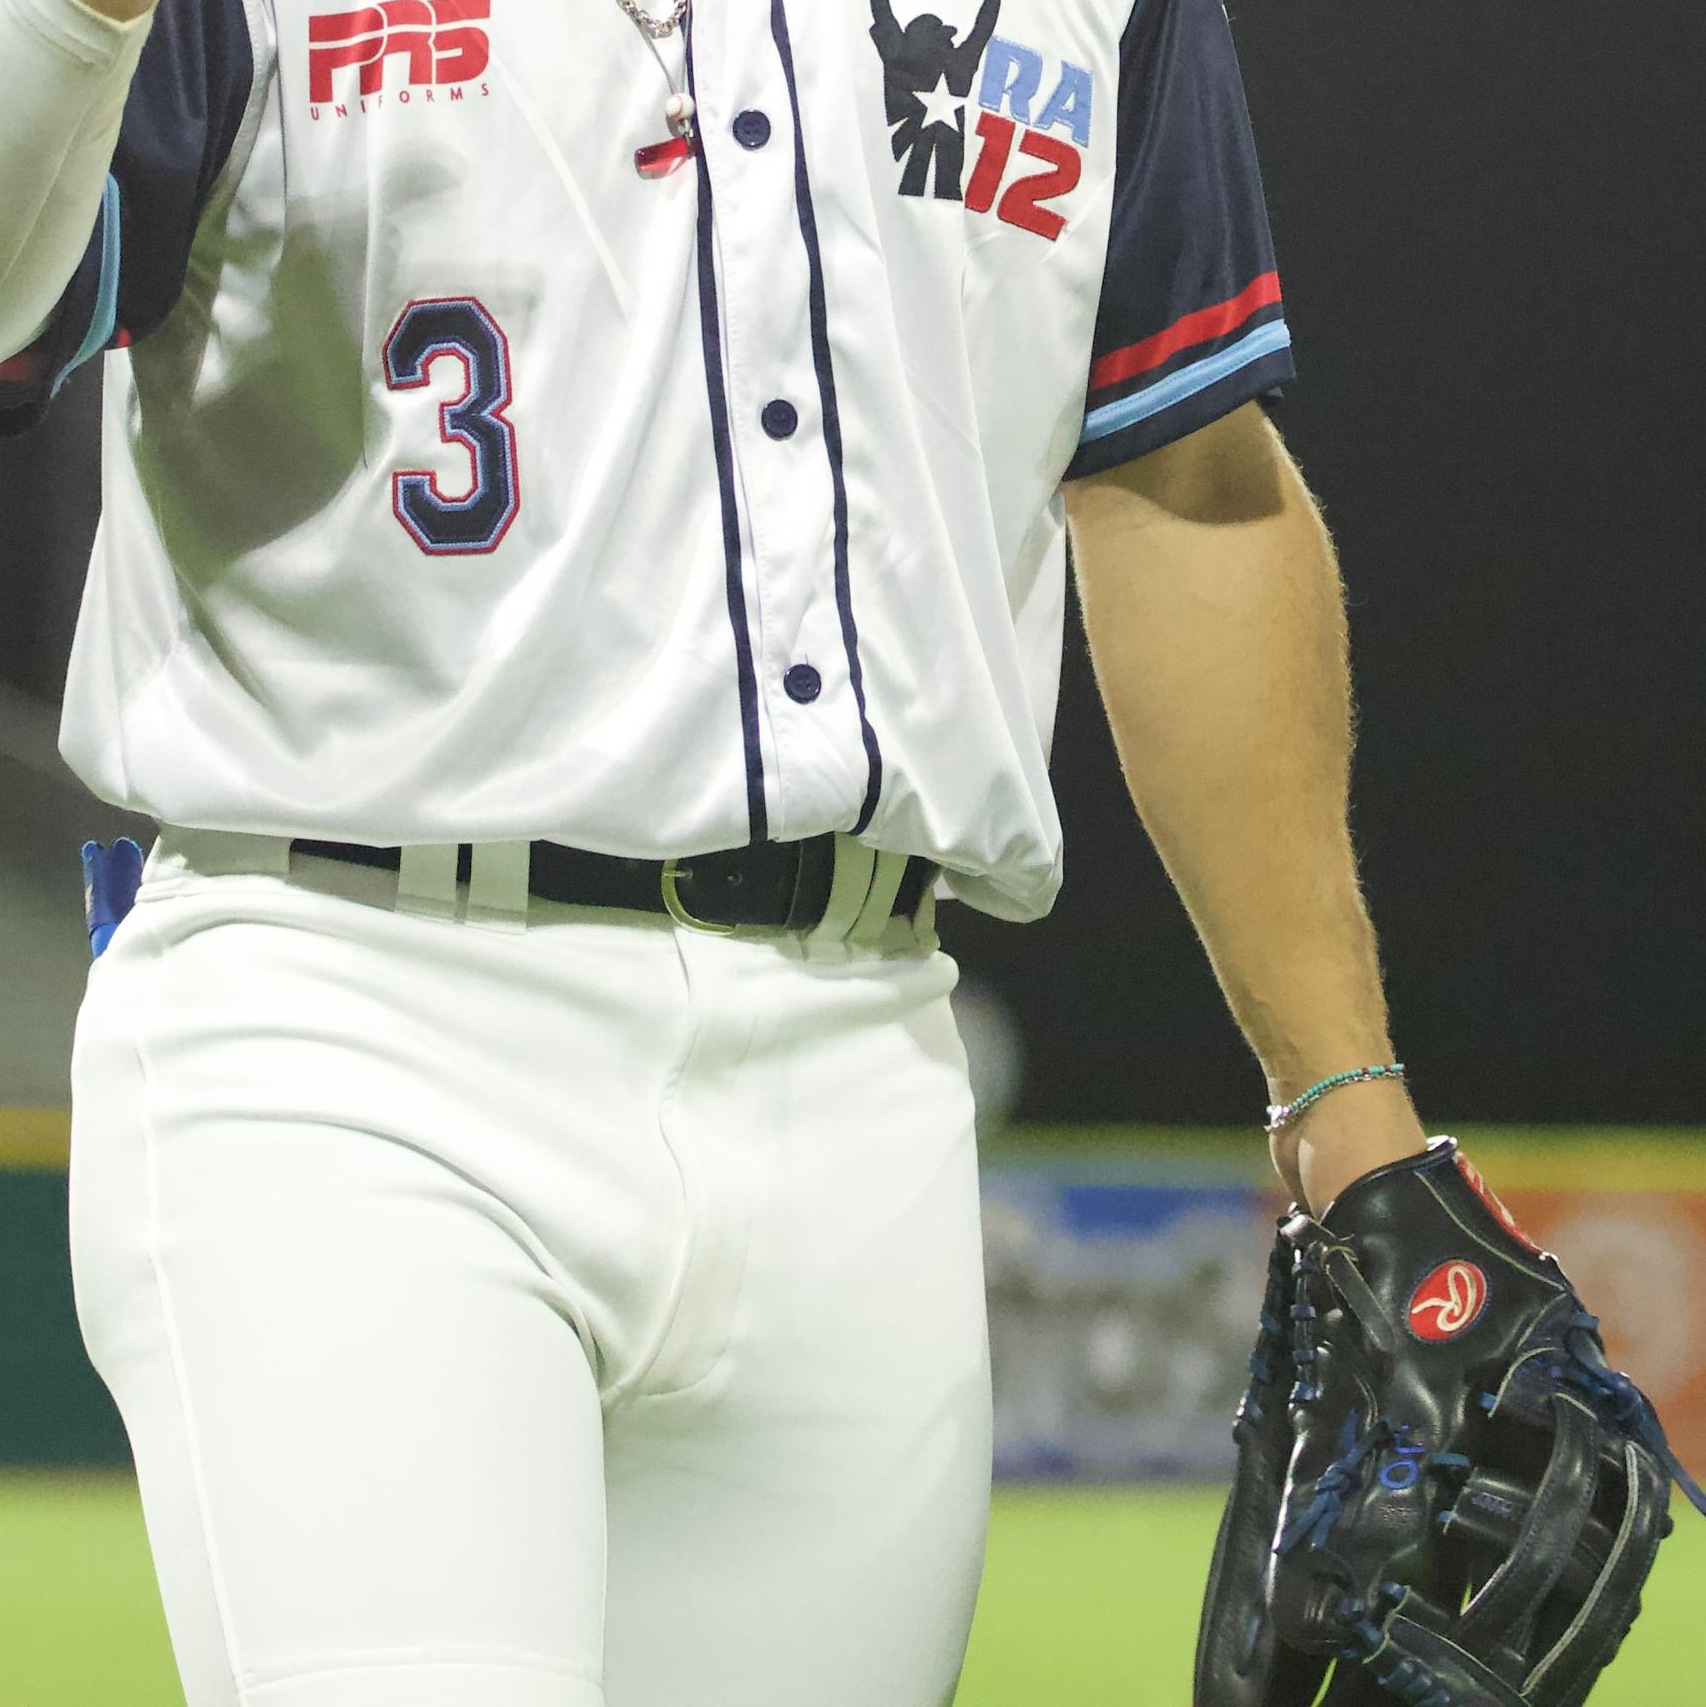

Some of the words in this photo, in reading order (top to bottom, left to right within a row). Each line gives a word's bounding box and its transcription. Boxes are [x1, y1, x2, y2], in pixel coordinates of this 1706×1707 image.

[309, 83, 490, 121] UNIFORMS
[964, 111, 1082, 243] 12
[381, 295, 521, 556] 3
